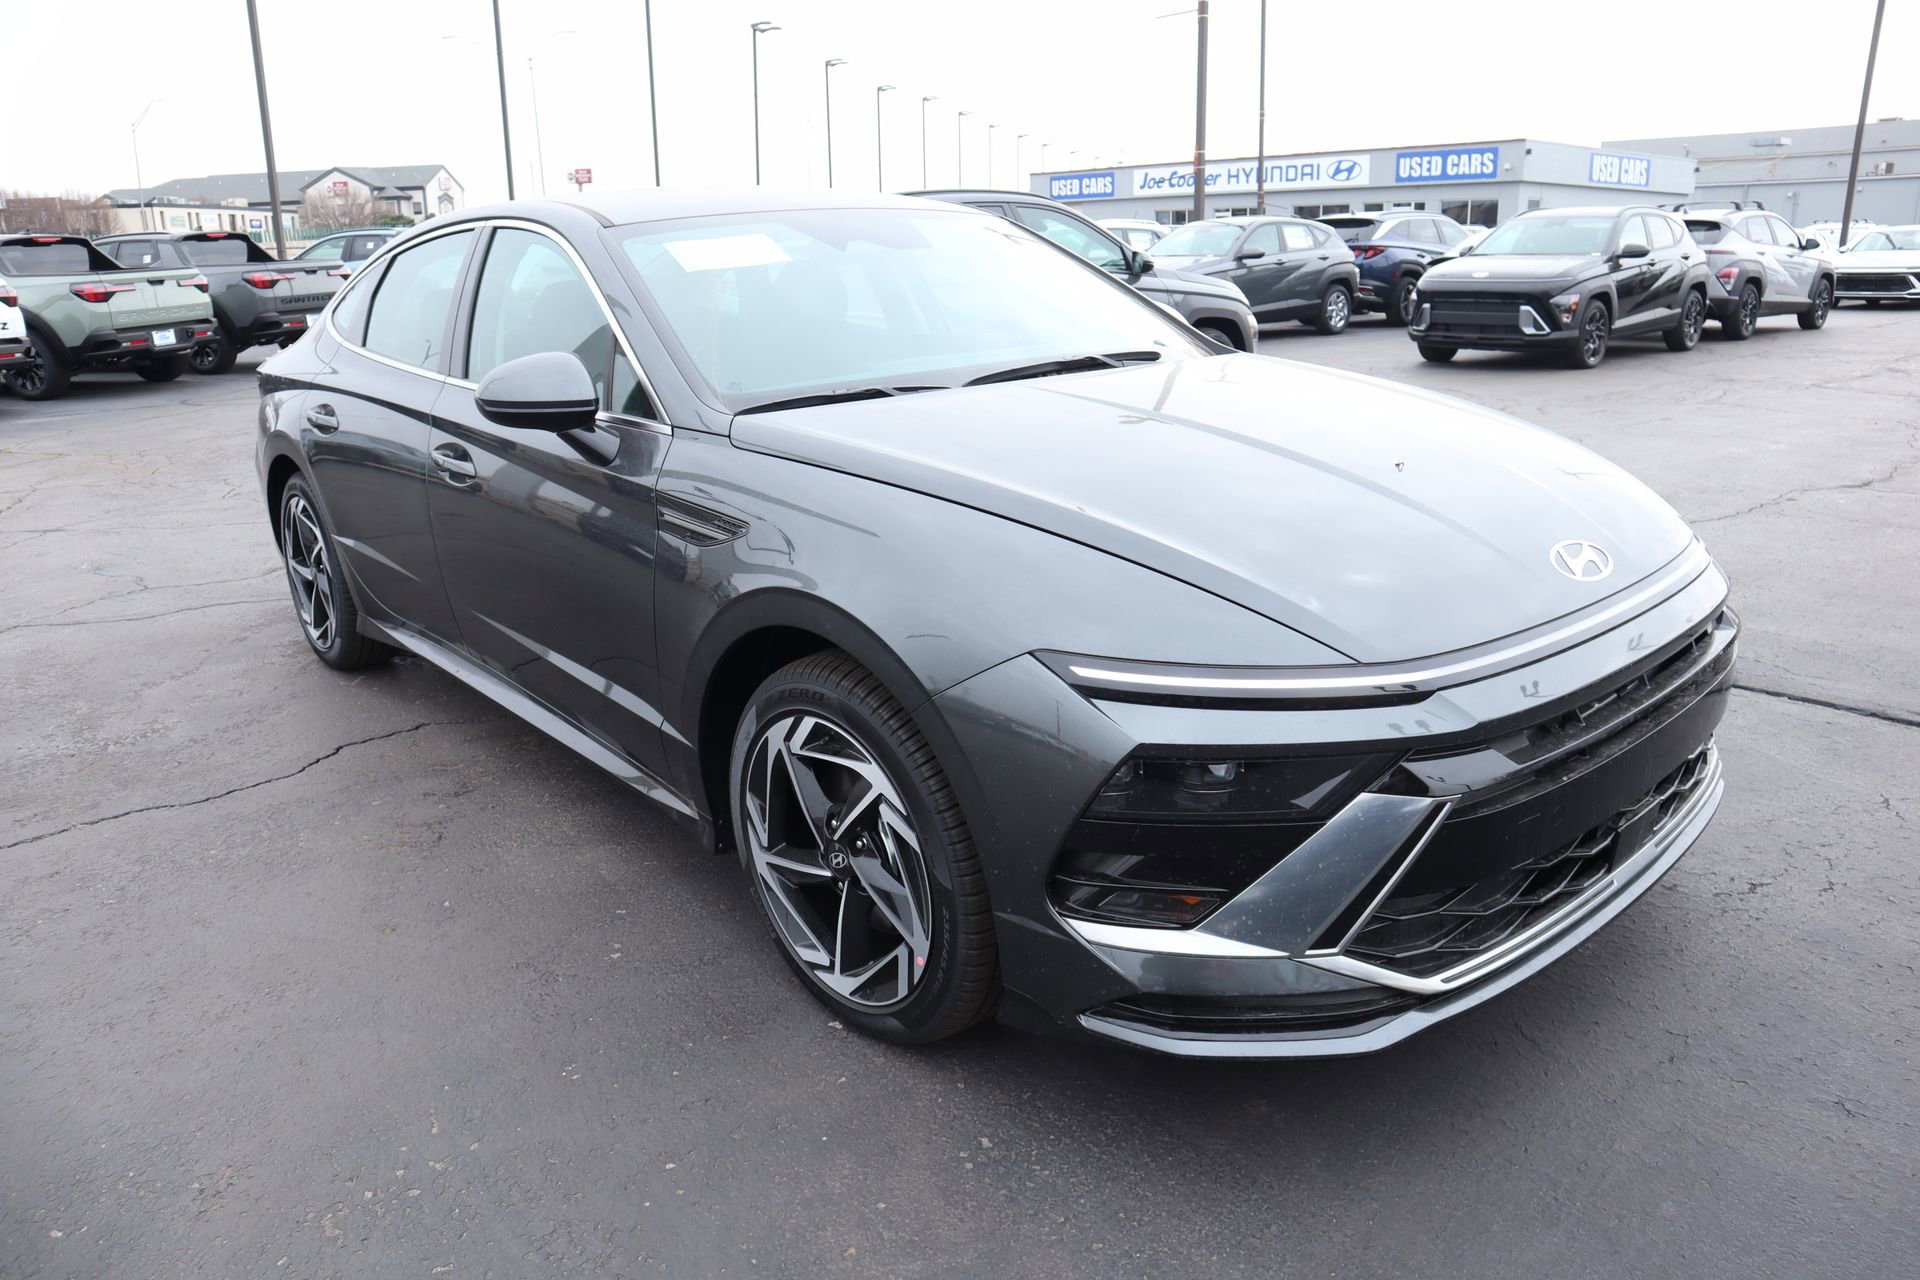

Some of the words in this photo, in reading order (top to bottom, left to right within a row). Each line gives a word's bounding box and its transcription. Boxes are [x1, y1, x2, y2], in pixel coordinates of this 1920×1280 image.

[1399, 155, 1442, 178] USED
[1446, 152, 1495, 176] CARS
[1592, 154, 1619, 183] USED
[1620, 157, 1648, 186] CARS
[1051, 178, 1080, 197] USED
[1081, 176, 1113, 195] CARS
[1140, 172, 1166, 190] Joe
[1168, 170, 1221, 188] Cooer
[777, 687, 825, 701] ZERO
